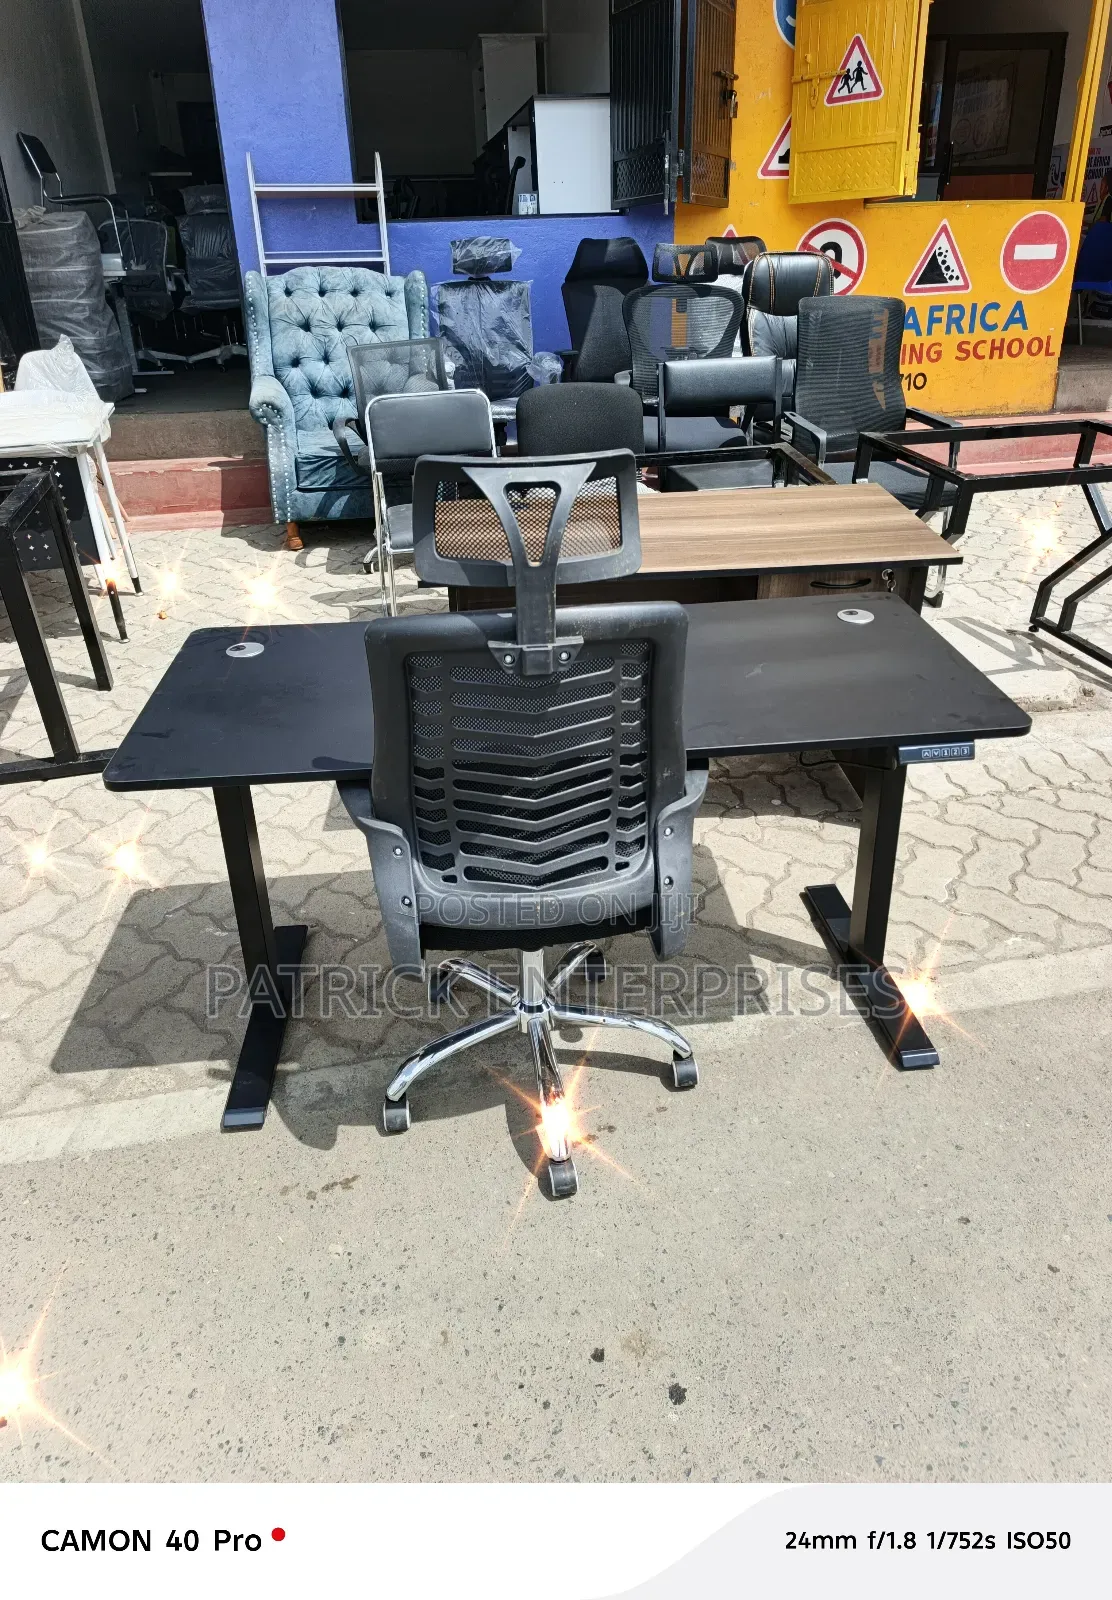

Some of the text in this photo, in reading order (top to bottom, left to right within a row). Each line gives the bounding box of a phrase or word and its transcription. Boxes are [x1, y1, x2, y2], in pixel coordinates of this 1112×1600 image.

[904, 300, 1029, 337] AFRICA
[899, 335, 1056, 366] ING SCHOOL
